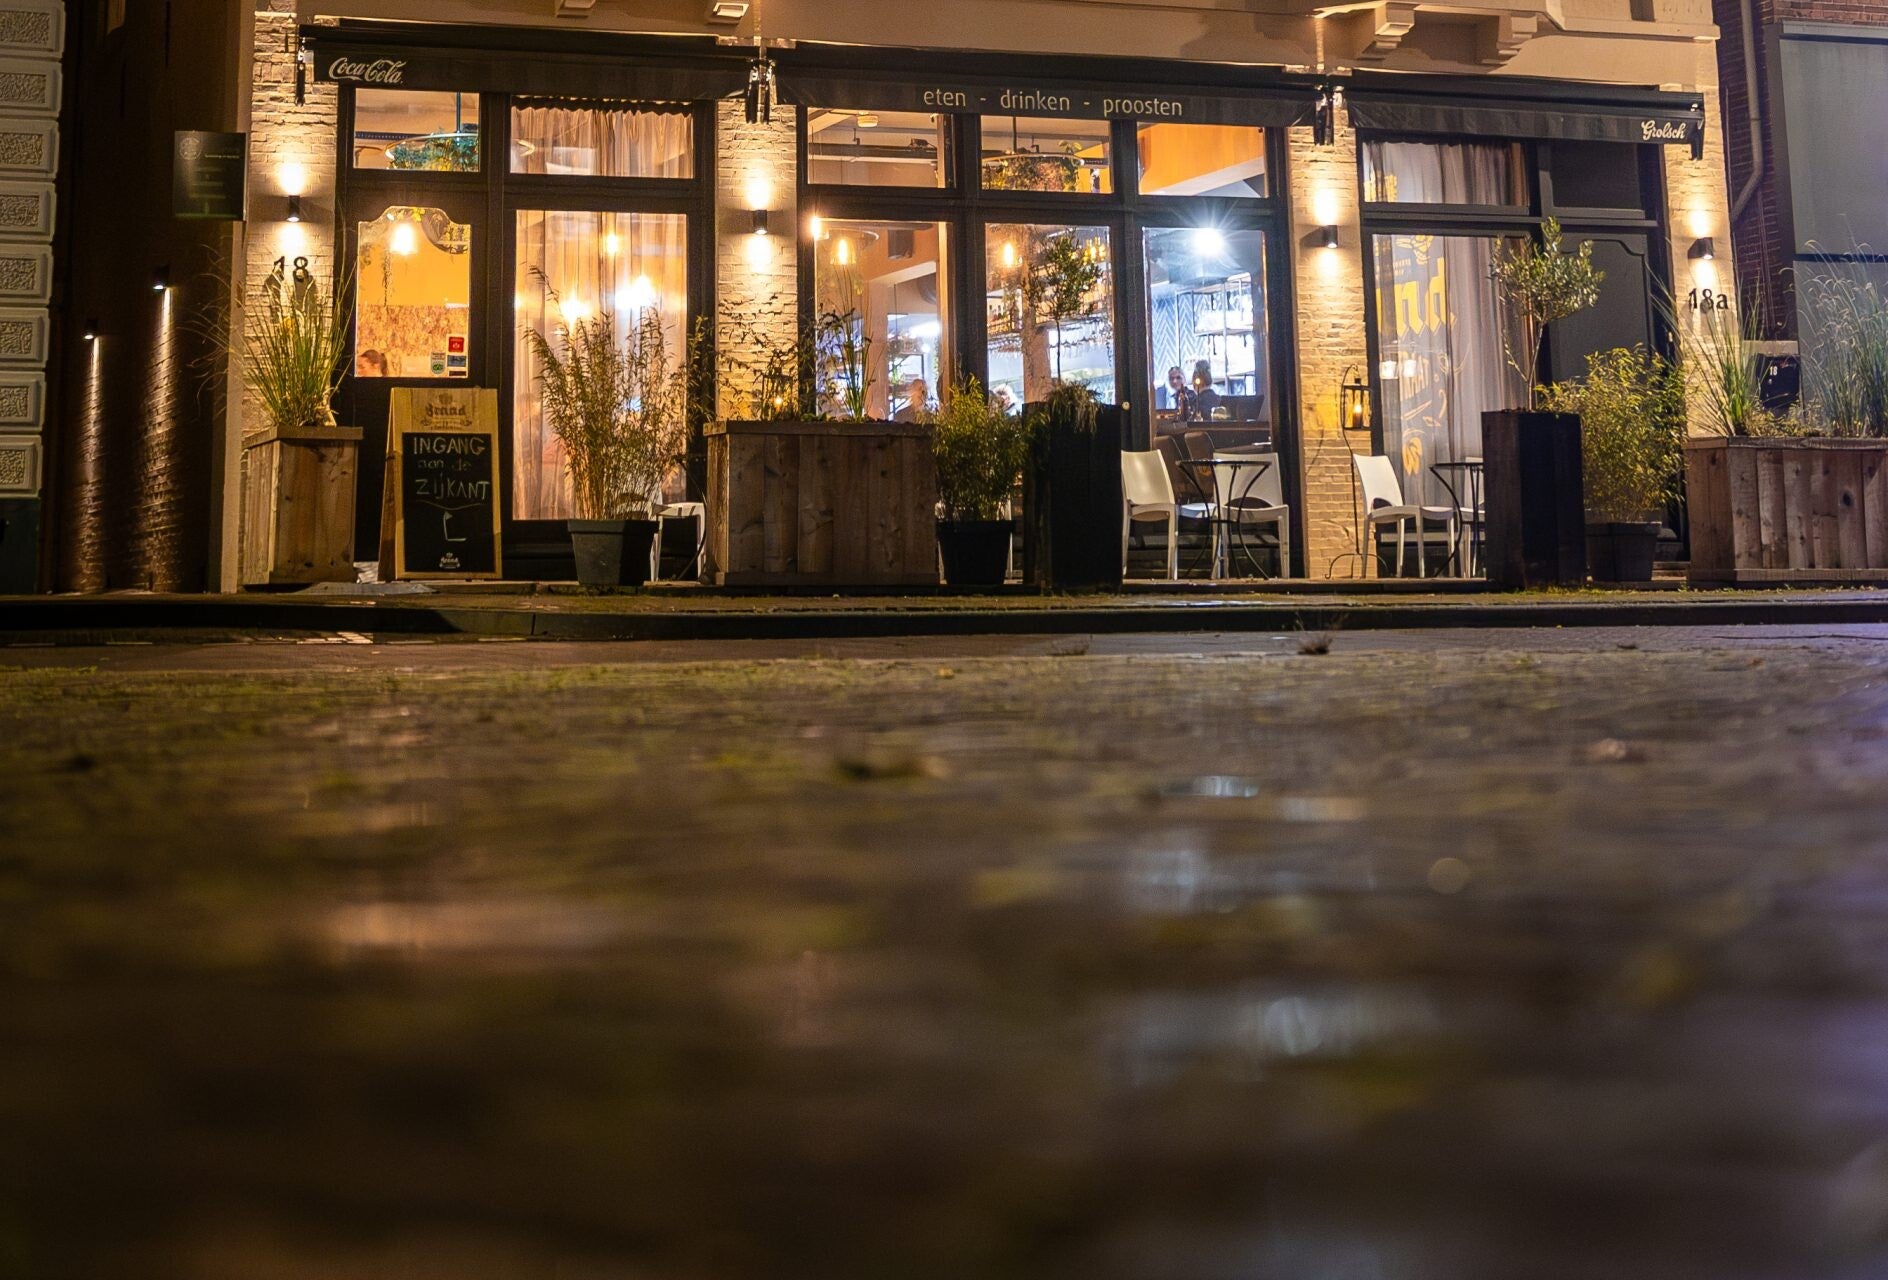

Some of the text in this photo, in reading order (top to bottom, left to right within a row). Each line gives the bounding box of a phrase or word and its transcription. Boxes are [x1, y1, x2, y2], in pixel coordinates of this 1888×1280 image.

[923, 88, 967, 107] eten
[1000, 89, 1070, 111] drinken
[1103, 97, 1183, 118] proosten
[1641, 120, 1687, 141] Grolsch
[273, 255, 309, 283] 18
[1688, 287, 1729, 310] 18a
[1769, 365, 1778, 376] 18
[413, 436, 486, 456] INGANG
